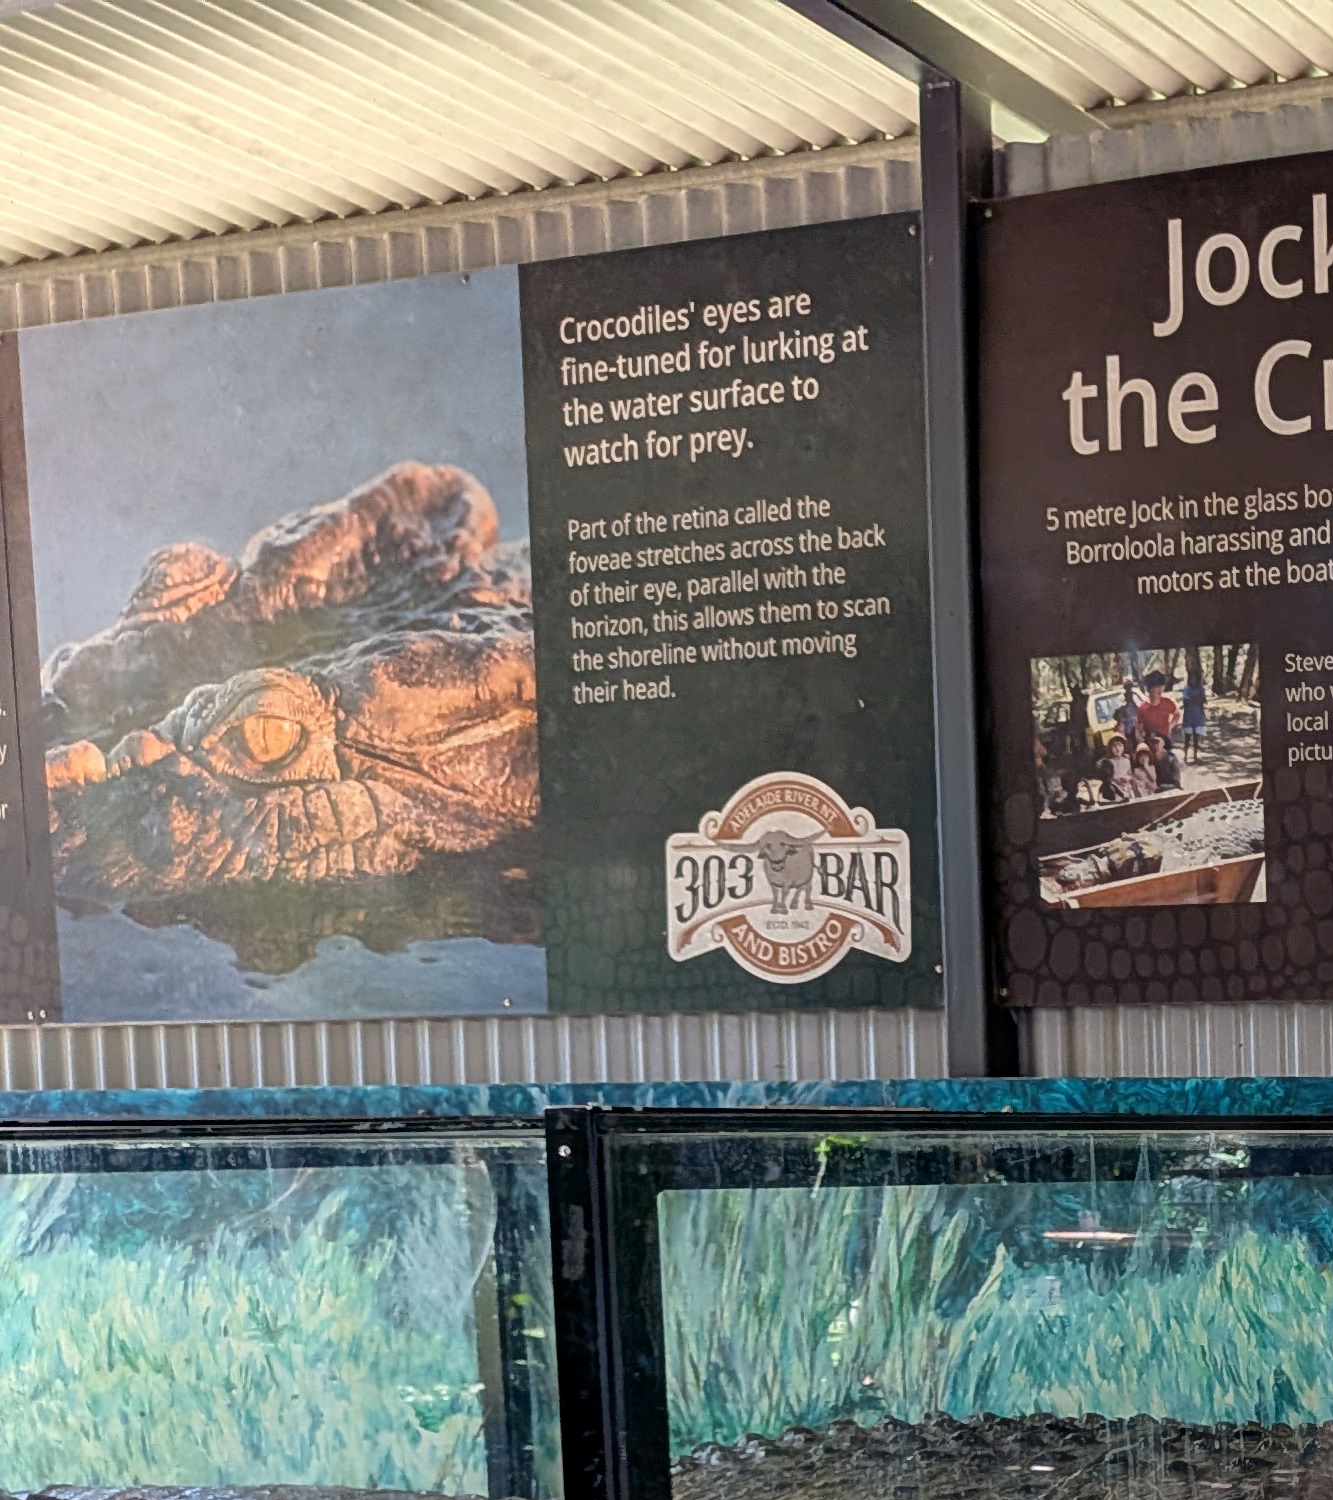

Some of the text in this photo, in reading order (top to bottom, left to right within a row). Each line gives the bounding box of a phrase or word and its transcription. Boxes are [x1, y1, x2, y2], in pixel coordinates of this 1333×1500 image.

[559, 292, 811, 345] Crocodiles' eyes are
[560, 325, 870, 386] fine-tuned for lurking at
[562, 375, 820, 427] the water surface to
[1061, 354, 1220, 456] the
[563, 427, 754, 468] watch for prey.
[567, 495, 831, 542] Part of the retina called the
[1046, 507, 1060, 531] 5
[1064, 505, 1127, 530] metre
[1128, 495, 1175, 529] Jock
[1178, 494, 1199, 519] in
[1203, 491, 1239, 517] the
[1243, 487, 1299, 521] glass
[568, 523, 887, 575] foveae stretches across the back
[1066, 532, 1175, 565] Borroloola
[1180, 525, 1285, 556] harassing
[1288, 519, 1331, 547] and
[570, 562, 847, 607] of their eye, parallel with the
[1137, 570, 1214, 595] motors
[1218, 566, 1241, 589] at
[1244, 560, 1281, 587] the
[1284, 681, 1326, 703] who
[674, 851, 905, 936] 303 BAR
[731, 919, 842, 966] AND BISTRO
